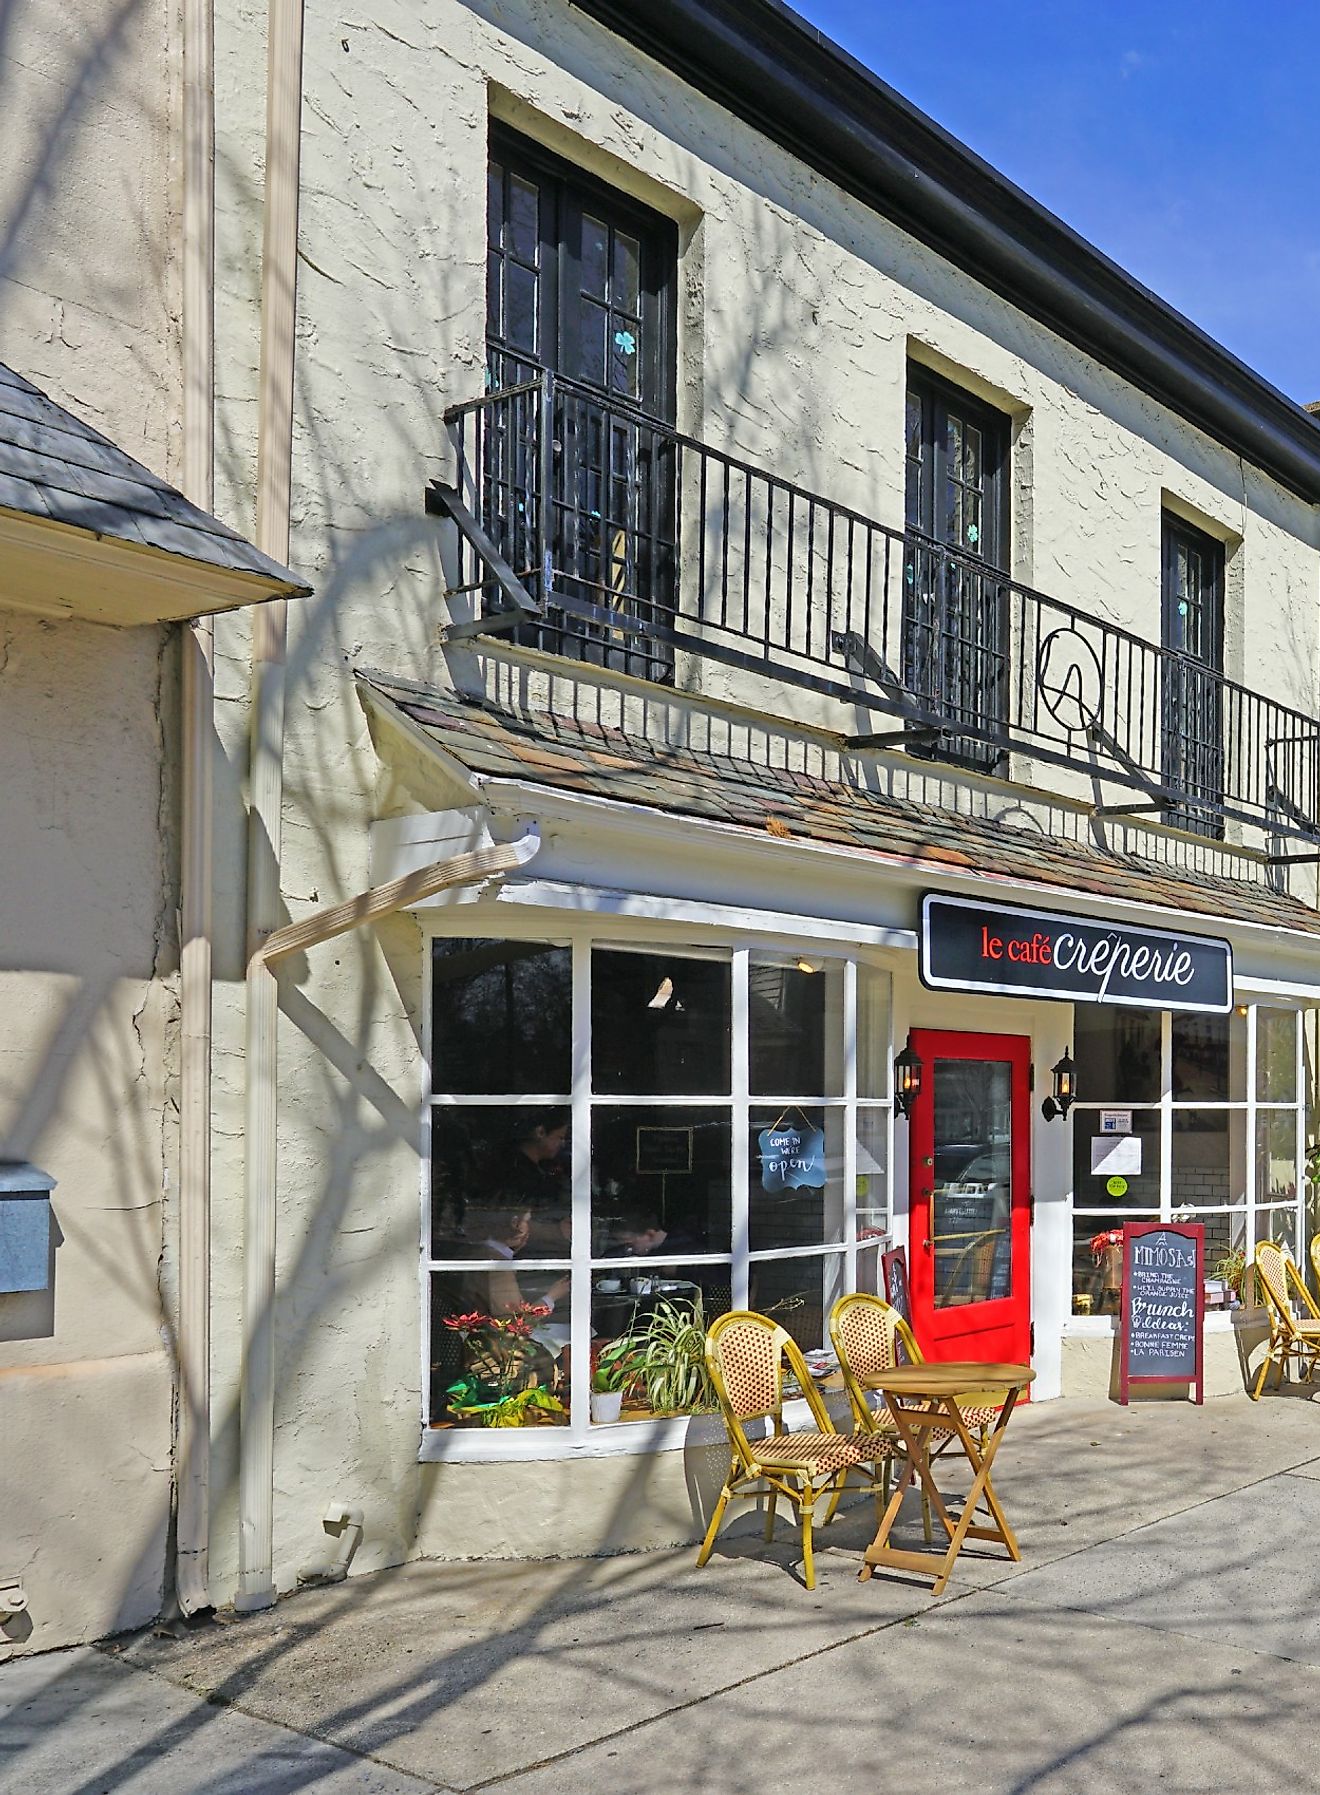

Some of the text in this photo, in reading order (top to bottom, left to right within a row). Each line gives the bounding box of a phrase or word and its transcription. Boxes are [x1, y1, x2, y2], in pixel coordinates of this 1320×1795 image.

[981, 926, 1003, 959] le
[1007, 933, 1052, 965] café
[770, 1137, 790, 1147] COME
[769, 1155, 815, 1181] open
[1131, 1296, 1194, 1318] Brunch
[1135, 1331, 1174, 1339] BREAKFAST
[1161, 1341, 1189, 1350] FEMME
[1133, 1348, 1145, 1356] LA
